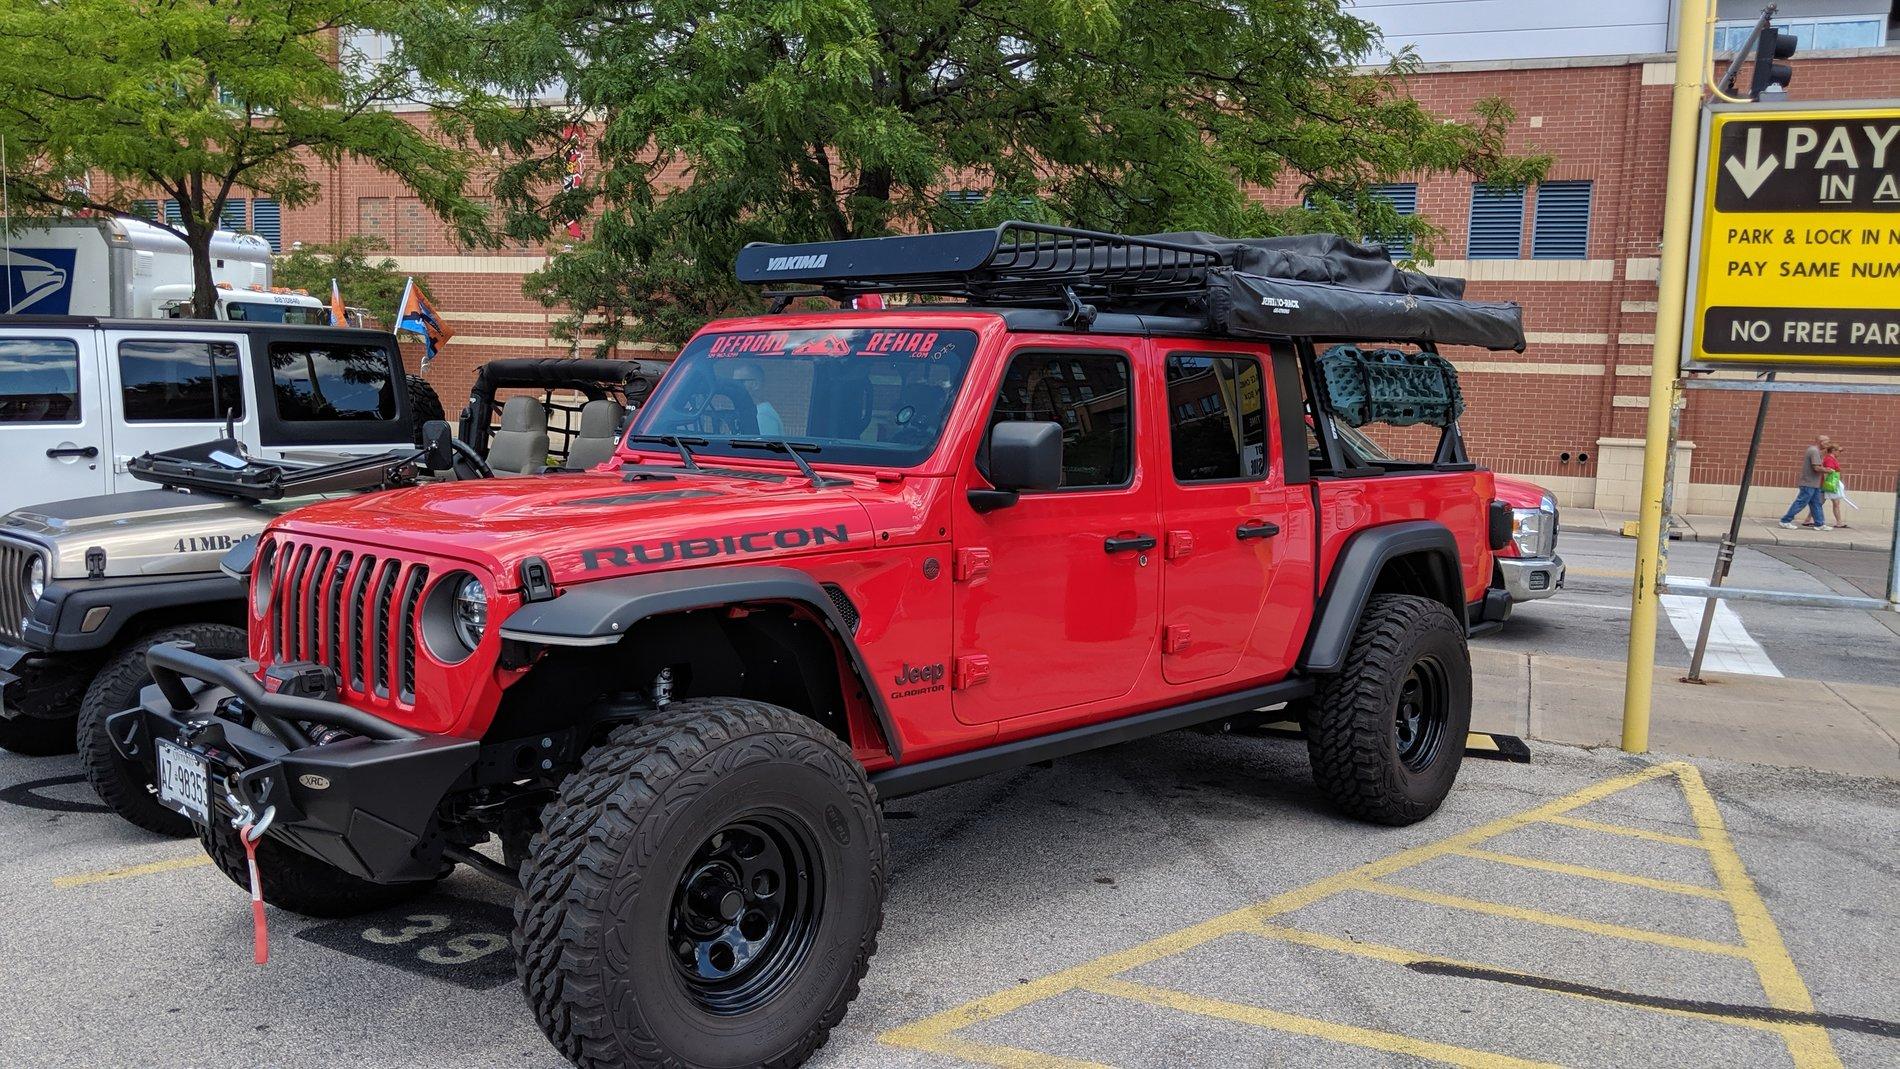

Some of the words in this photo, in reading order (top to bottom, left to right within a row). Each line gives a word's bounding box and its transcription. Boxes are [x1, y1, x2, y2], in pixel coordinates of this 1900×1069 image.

[1784, 125, 1900, 169] PAY
[1820, 174, 1856, 204] IN
[1728, 229, 1774, 244] PARK
[1784, 229, 1795, 244] &
[1805, 229, 1852, 245] LOCK
[1861, 229, 1880, 245] IN
[766, 254, 828, 271] YAKIMA
[1727, 261, 1768, 276] PAY
[1779, 261, 1840, 278] SAME
[1851, 262, 1900, 278] NUM
[709, 333, 790, 354] OFFROAD
[865, 331, 940, 353] REHAB
[1730, 320, 1770, 342] NO
[1783, 321, 1838, 343] FREE
[1849, 322, 1900, 345] PAR
[582, 524, 849, 571] RUBICON
[894, 662, 944, 686] Jeep
[891, 684, 945, 699] GLADIATOR
[160, 758, 173, 791] AZ
[305, 775, 324, 787] XRC
[361, 914, 511, 965] 39
